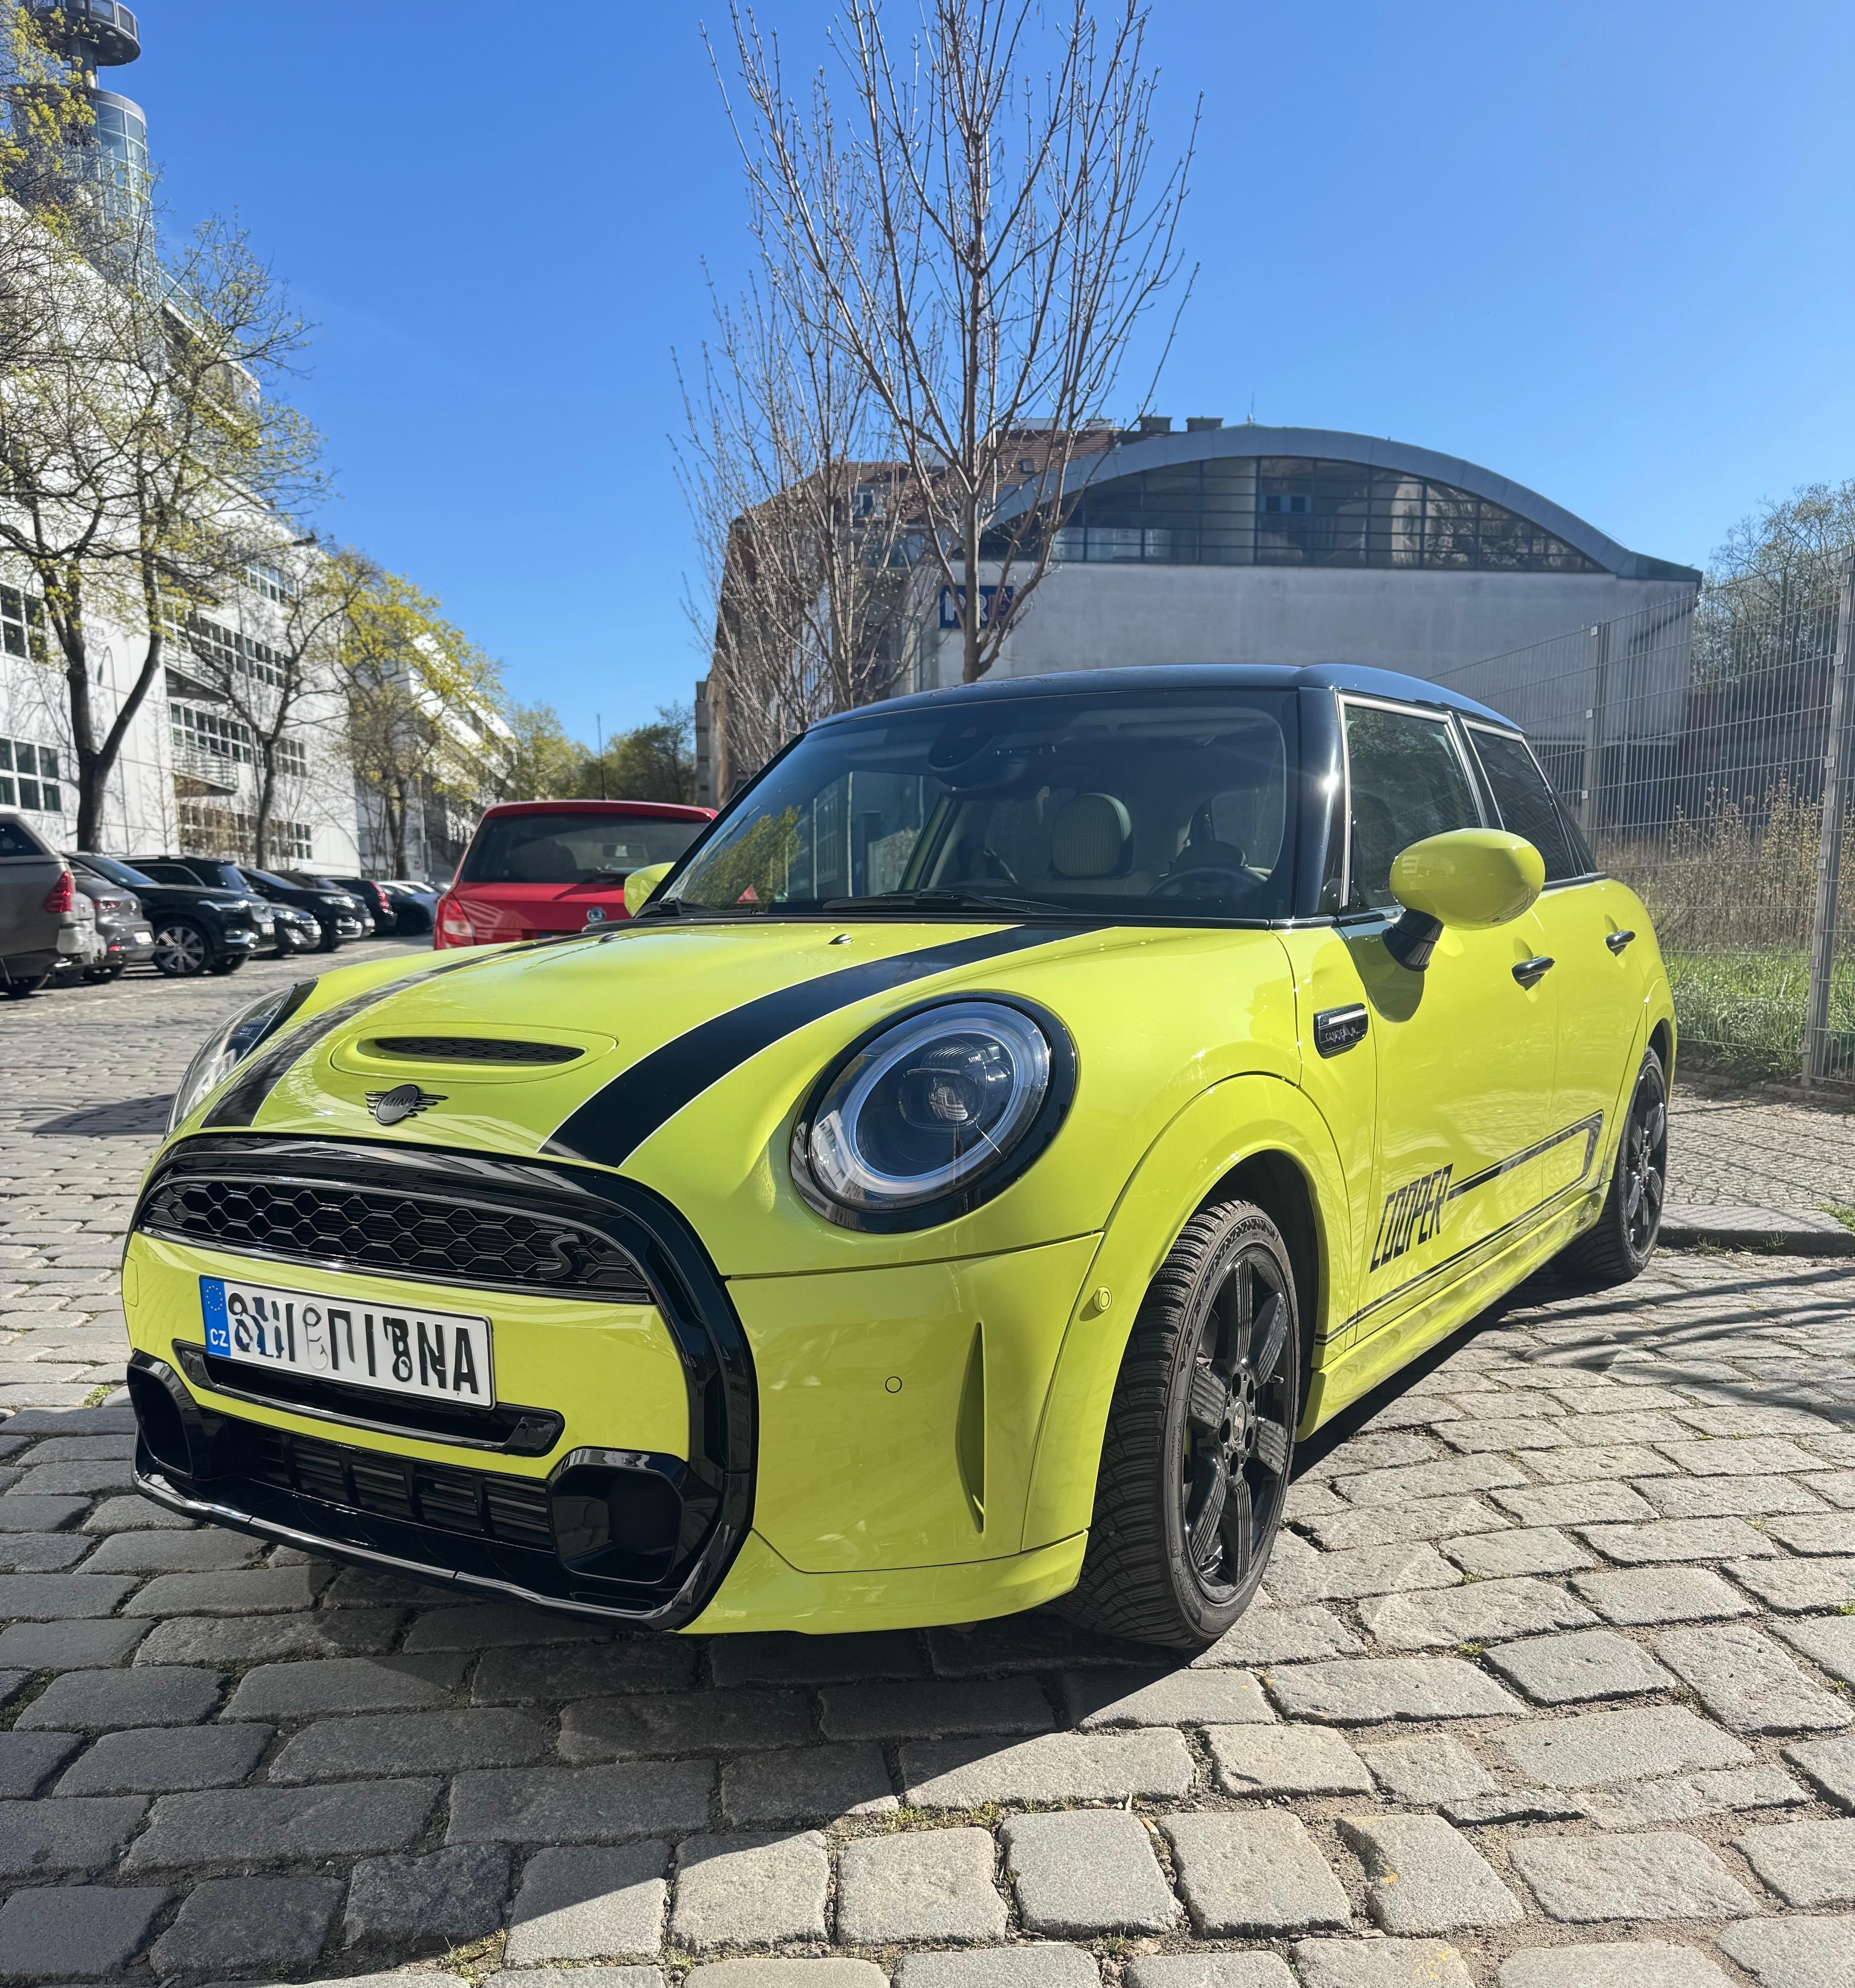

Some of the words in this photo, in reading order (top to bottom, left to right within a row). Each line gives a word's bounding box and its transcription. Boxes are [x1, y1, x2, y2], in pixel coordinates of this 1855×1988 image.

[382, 1096, 412, 1108] MINI
[1369, 1163, 1453, 1274] COOPER
[210, 1327, 229, 1348] CZ
